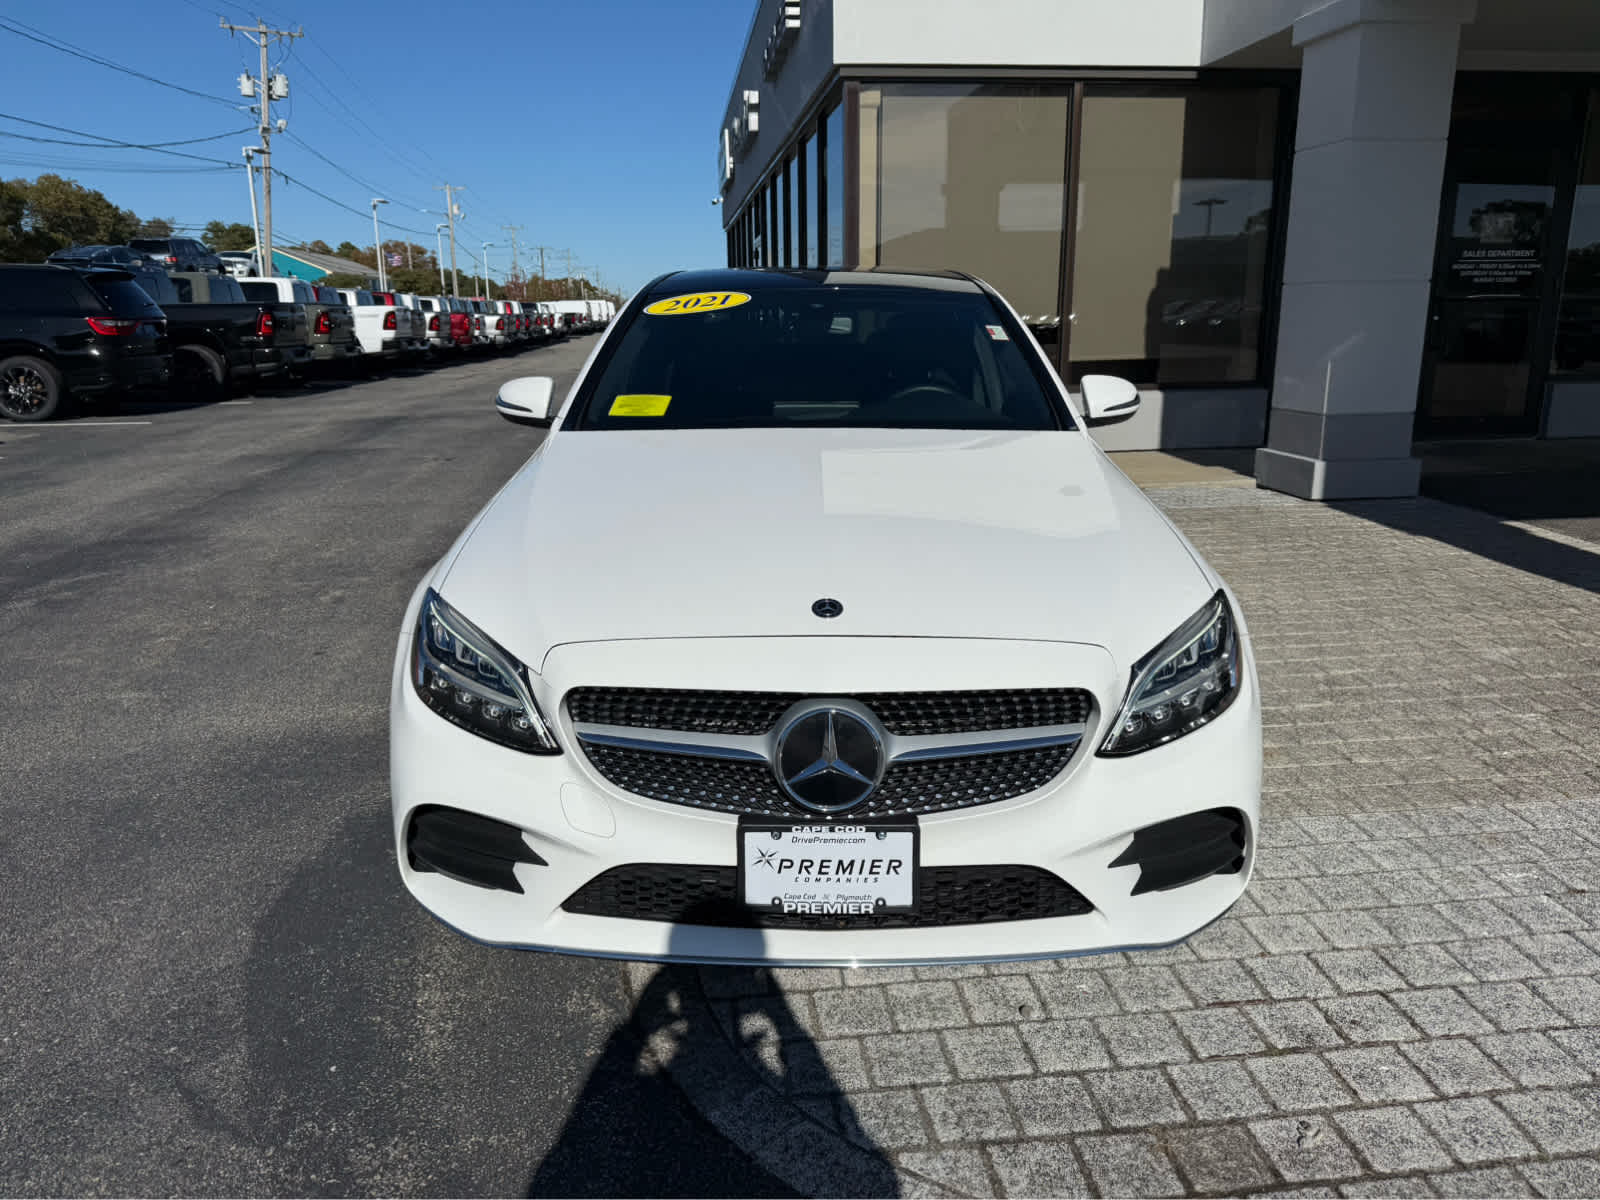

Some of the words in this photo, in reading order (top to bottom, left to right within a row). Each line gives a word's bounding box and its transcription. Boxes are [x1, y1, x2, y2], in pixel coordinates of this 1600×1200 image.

[1487, 249, 1536, 257] DEPARTMENT
[663, 294, 732, 312] 2021
[792, 825, 830, 833] CAPE
[835, 825, 866, 833] COD
[791, 836, 866, 844] DrivePremier.com
[777, 859, 903, 875] PREMIER
[783, 893, 802, 901] Cape
[836, 893, 872, 901] Plymouth
[783, 902, 874, 914] PREMIER
